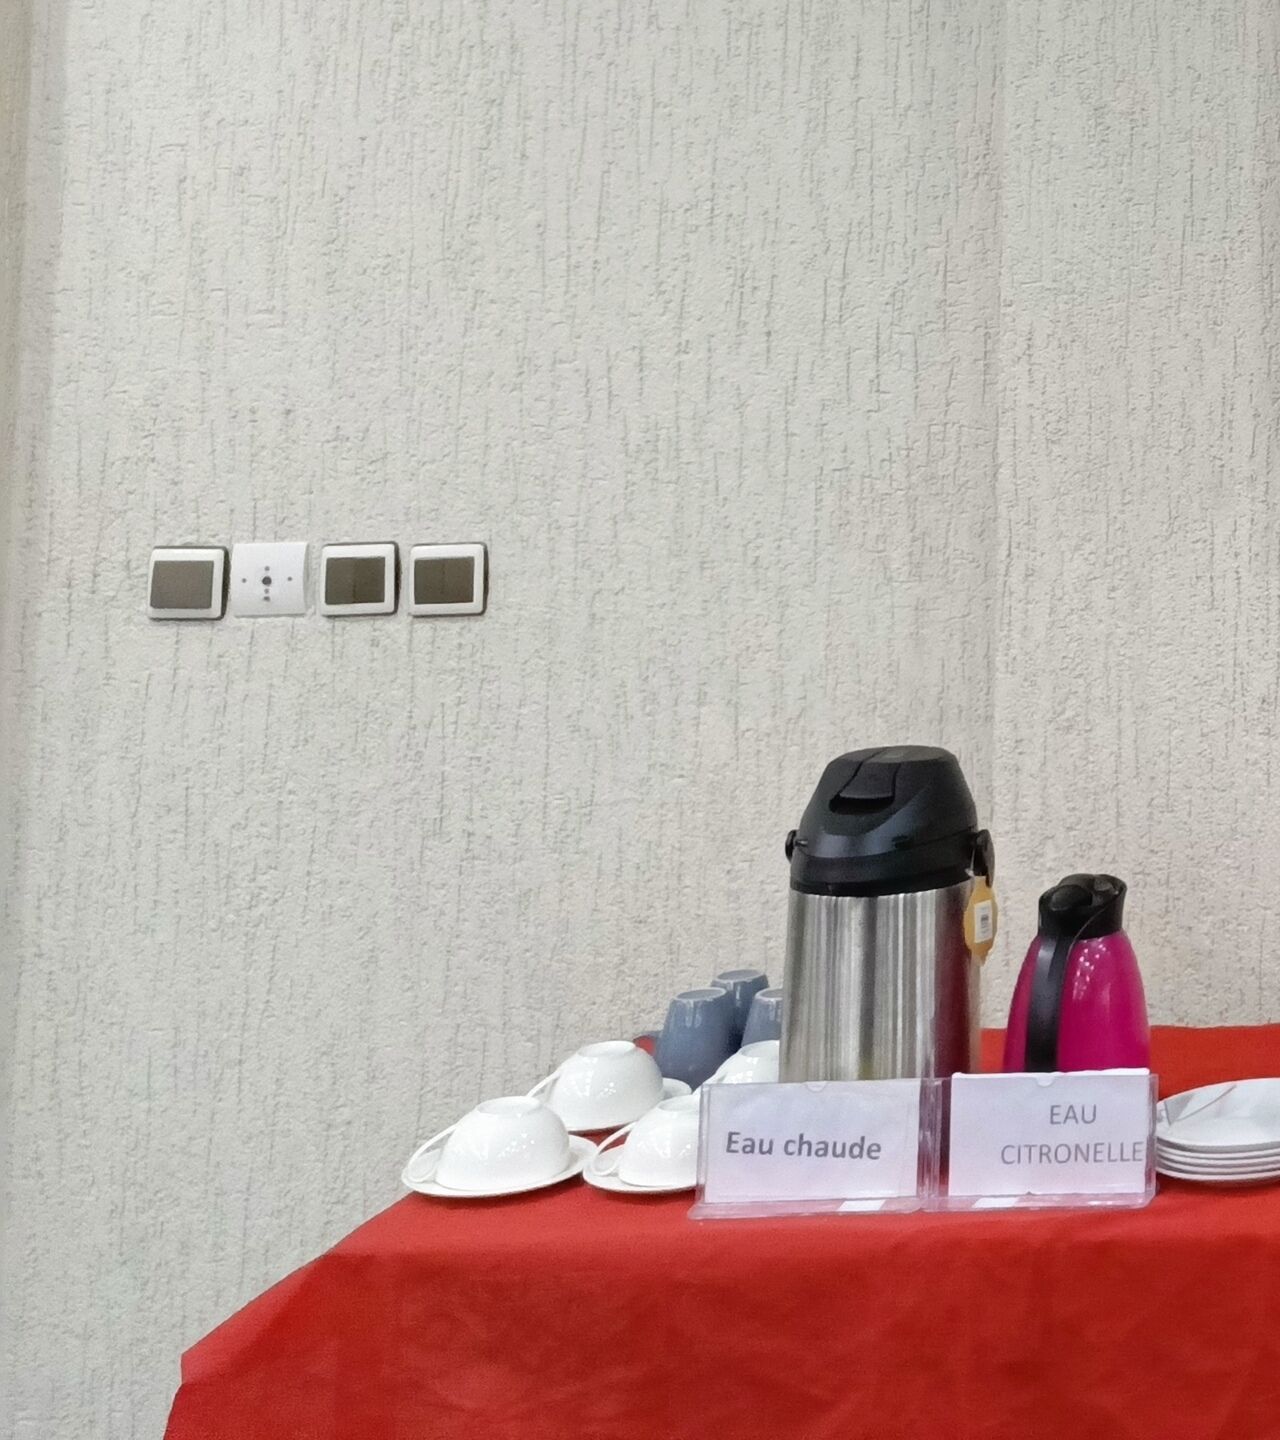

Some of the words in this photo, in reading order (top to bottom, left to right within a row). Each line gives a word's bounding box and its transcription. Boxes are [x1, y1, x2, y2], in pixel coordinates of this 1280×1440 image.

[1049, 1103, 1098, 1126] EAU
[725, 1131, 775, 1157] Eau
[783, 1133, 882, 1161] chaude
[1000, 1140, 1145, 1166] CITRONELLE
